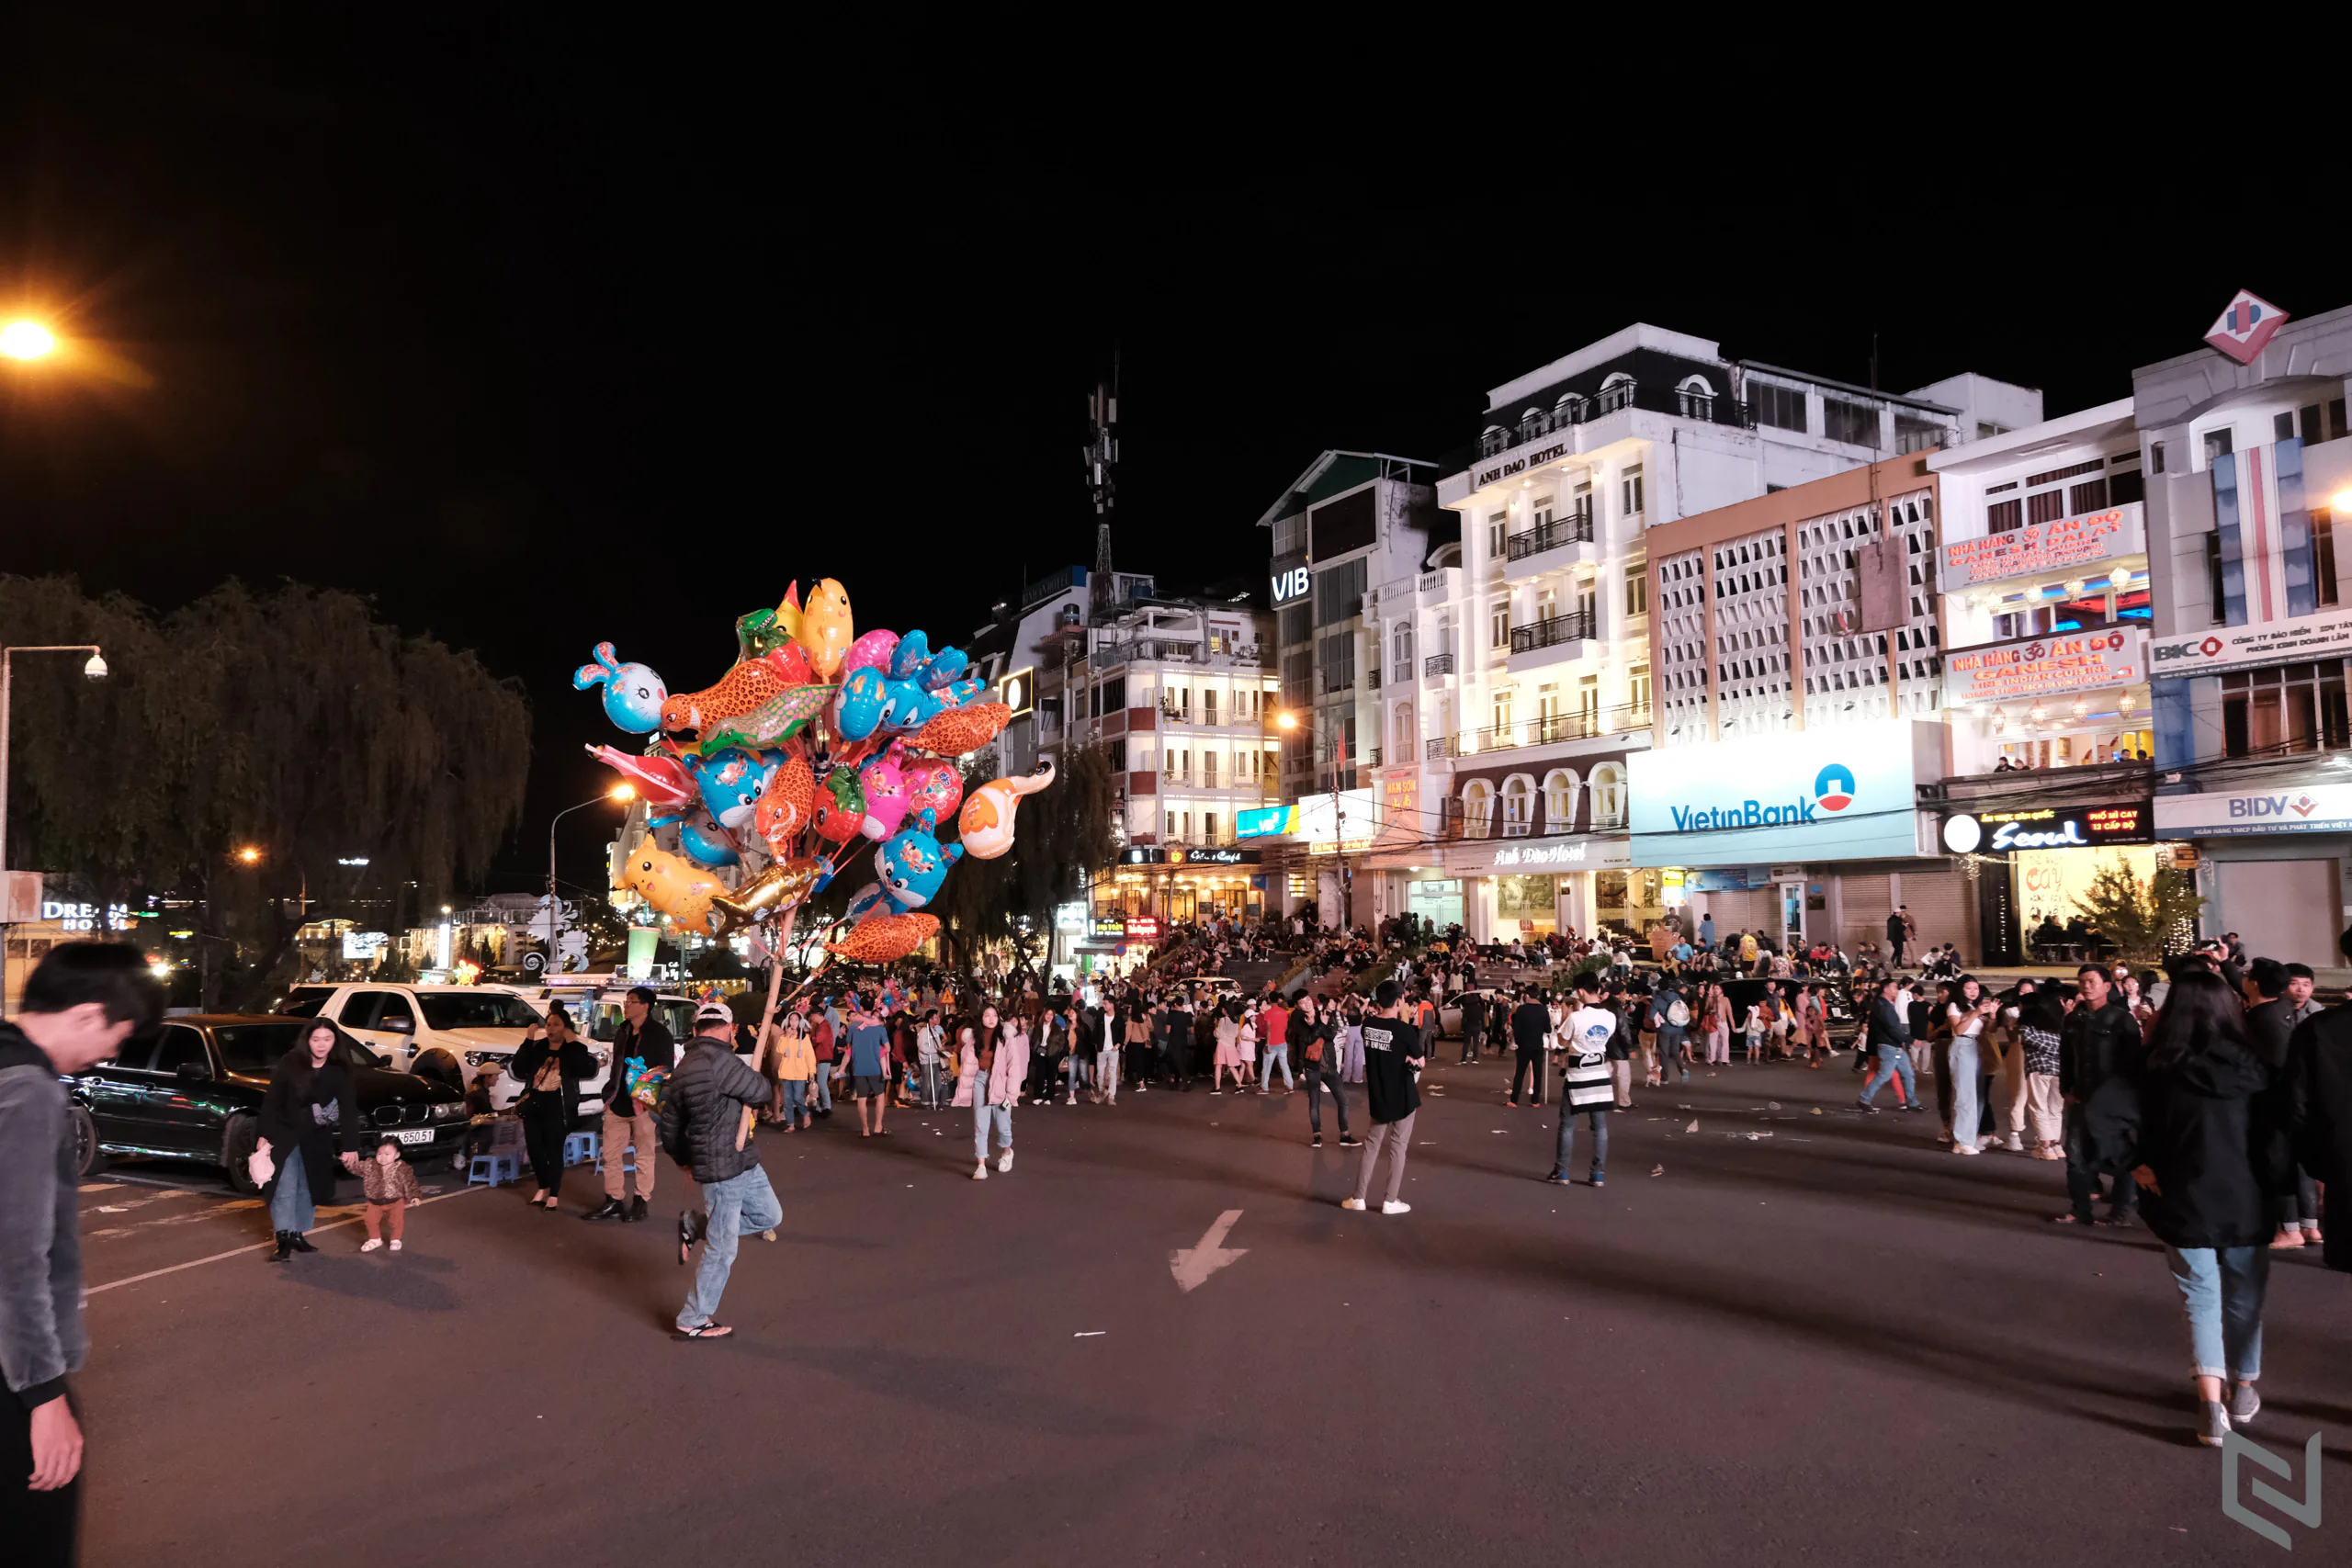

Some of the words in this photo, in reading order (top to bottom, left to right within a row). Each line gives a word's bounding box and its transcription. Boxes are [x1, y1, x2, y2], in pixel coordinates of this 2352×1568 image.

[1478, 467, 1501, 486] ANH
[1529, 443, 1567, 467] HOTEL
[2048, 519, 2081, 536] ẤN
[1949, 543, 1975, 558] NHÀ
[1979, 534, 2015, 551] HÀNG
[1950, 541, 2039, 567] GANESH
[1272, 566, 1309, 601] VIB
[2050, 637, 2085, 658] ẤN
[2089, 630, 2124, 651] ĐỘ
[2232, 634, 2254, 645] CÔNG
[2257, 634, 2267, 642] TY
[2271, 629, 2288, 639] BẢO
[2332, 631, 2349, 641] LÂM
[1953, 653, 1982, 671] NHÀ
[1983, 649, 2020, 667] HÀNG
[2154, 641, 2199, 661] BIC
[1971, 679, 2002, 690] FINE
[2004, 672, 2051, 685] INDIAN
[2052, 665, 2111, 680] CUISINE
[1974, 653, 2103, 681] GANESH
[1670, 795, 1817, 831] VietinBank
[2109, 811, 2119, 819] MÌ
[2120, 810, 2138, 818] CAY
[2229, 795, 2289, 818] BIDV
[1992, 820, 2088, 850] Seoul
[2104, 820, 2120, 830] CẤP
[2122, 820, 2136, 830] ĐỘ
[42, 901, 129, 919] DREM
[62, 919, 129, 931] HOEL
